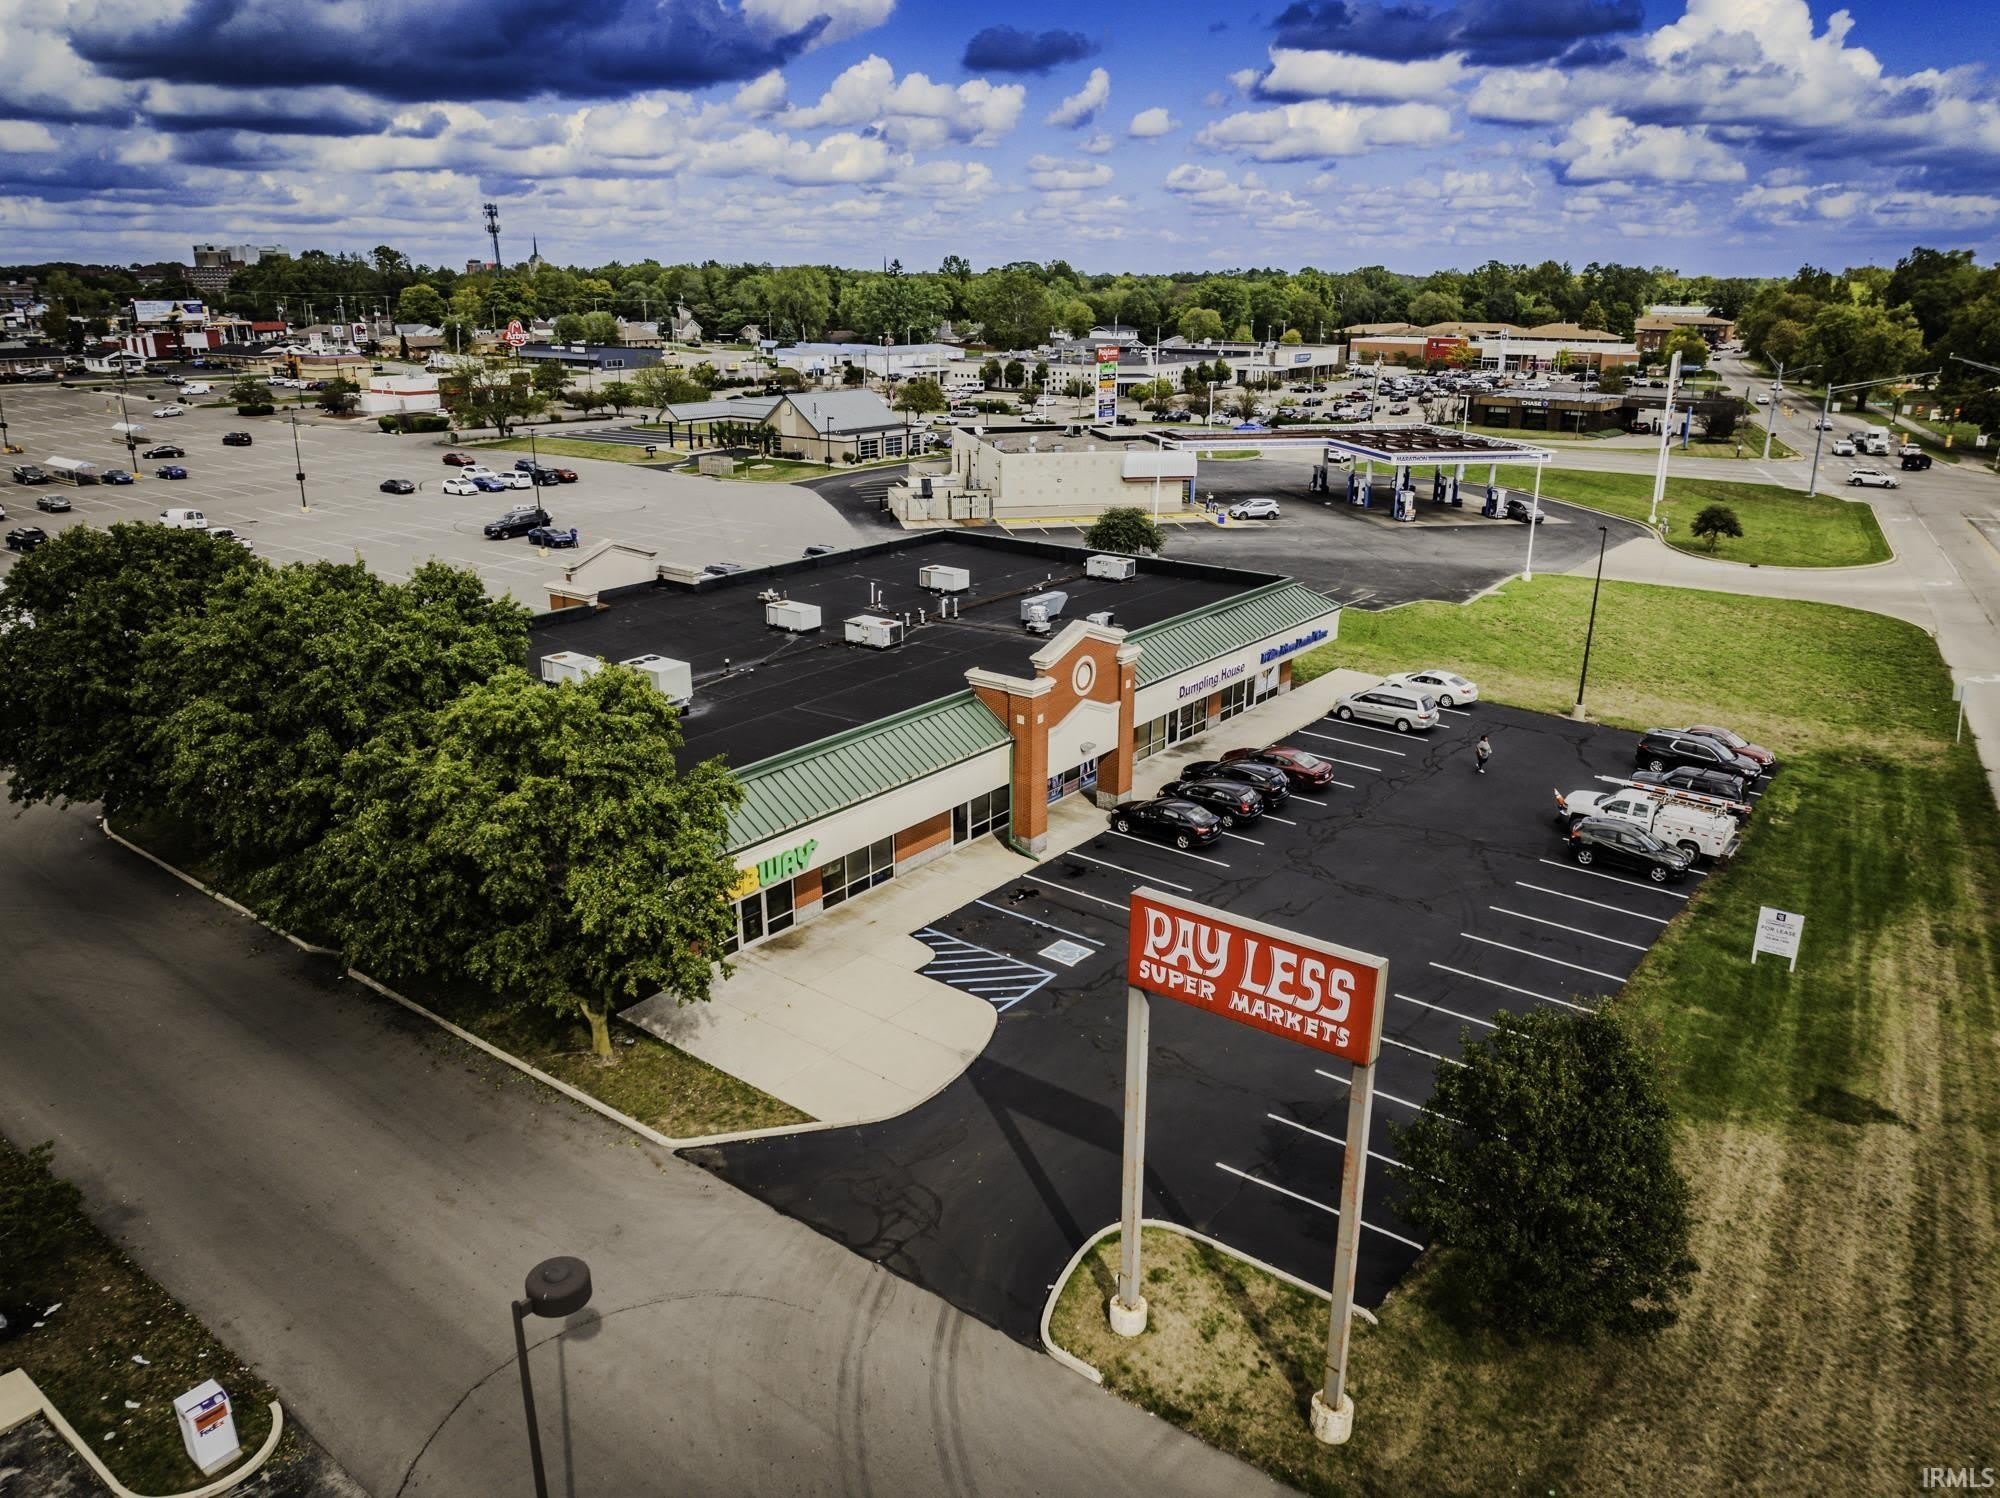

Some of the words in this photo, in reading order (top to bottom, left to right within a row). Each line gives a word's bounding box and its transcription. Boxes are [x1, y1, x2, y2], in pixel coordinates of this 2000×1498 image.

[1179, 675, 1219, 699] Dumpling
[1221, 663, 1246, 680] House
[725, 838, 819, 899] UBWAY
[1776, 928, 1796, 937] LEASE
[1144, 906, 1232, 978] PAY
[1239, 938, 1355, 1023] LESS
[1139, 959, 1217, 1001] SUPER
[1228, 990, 1351, 1048] MARKETS
